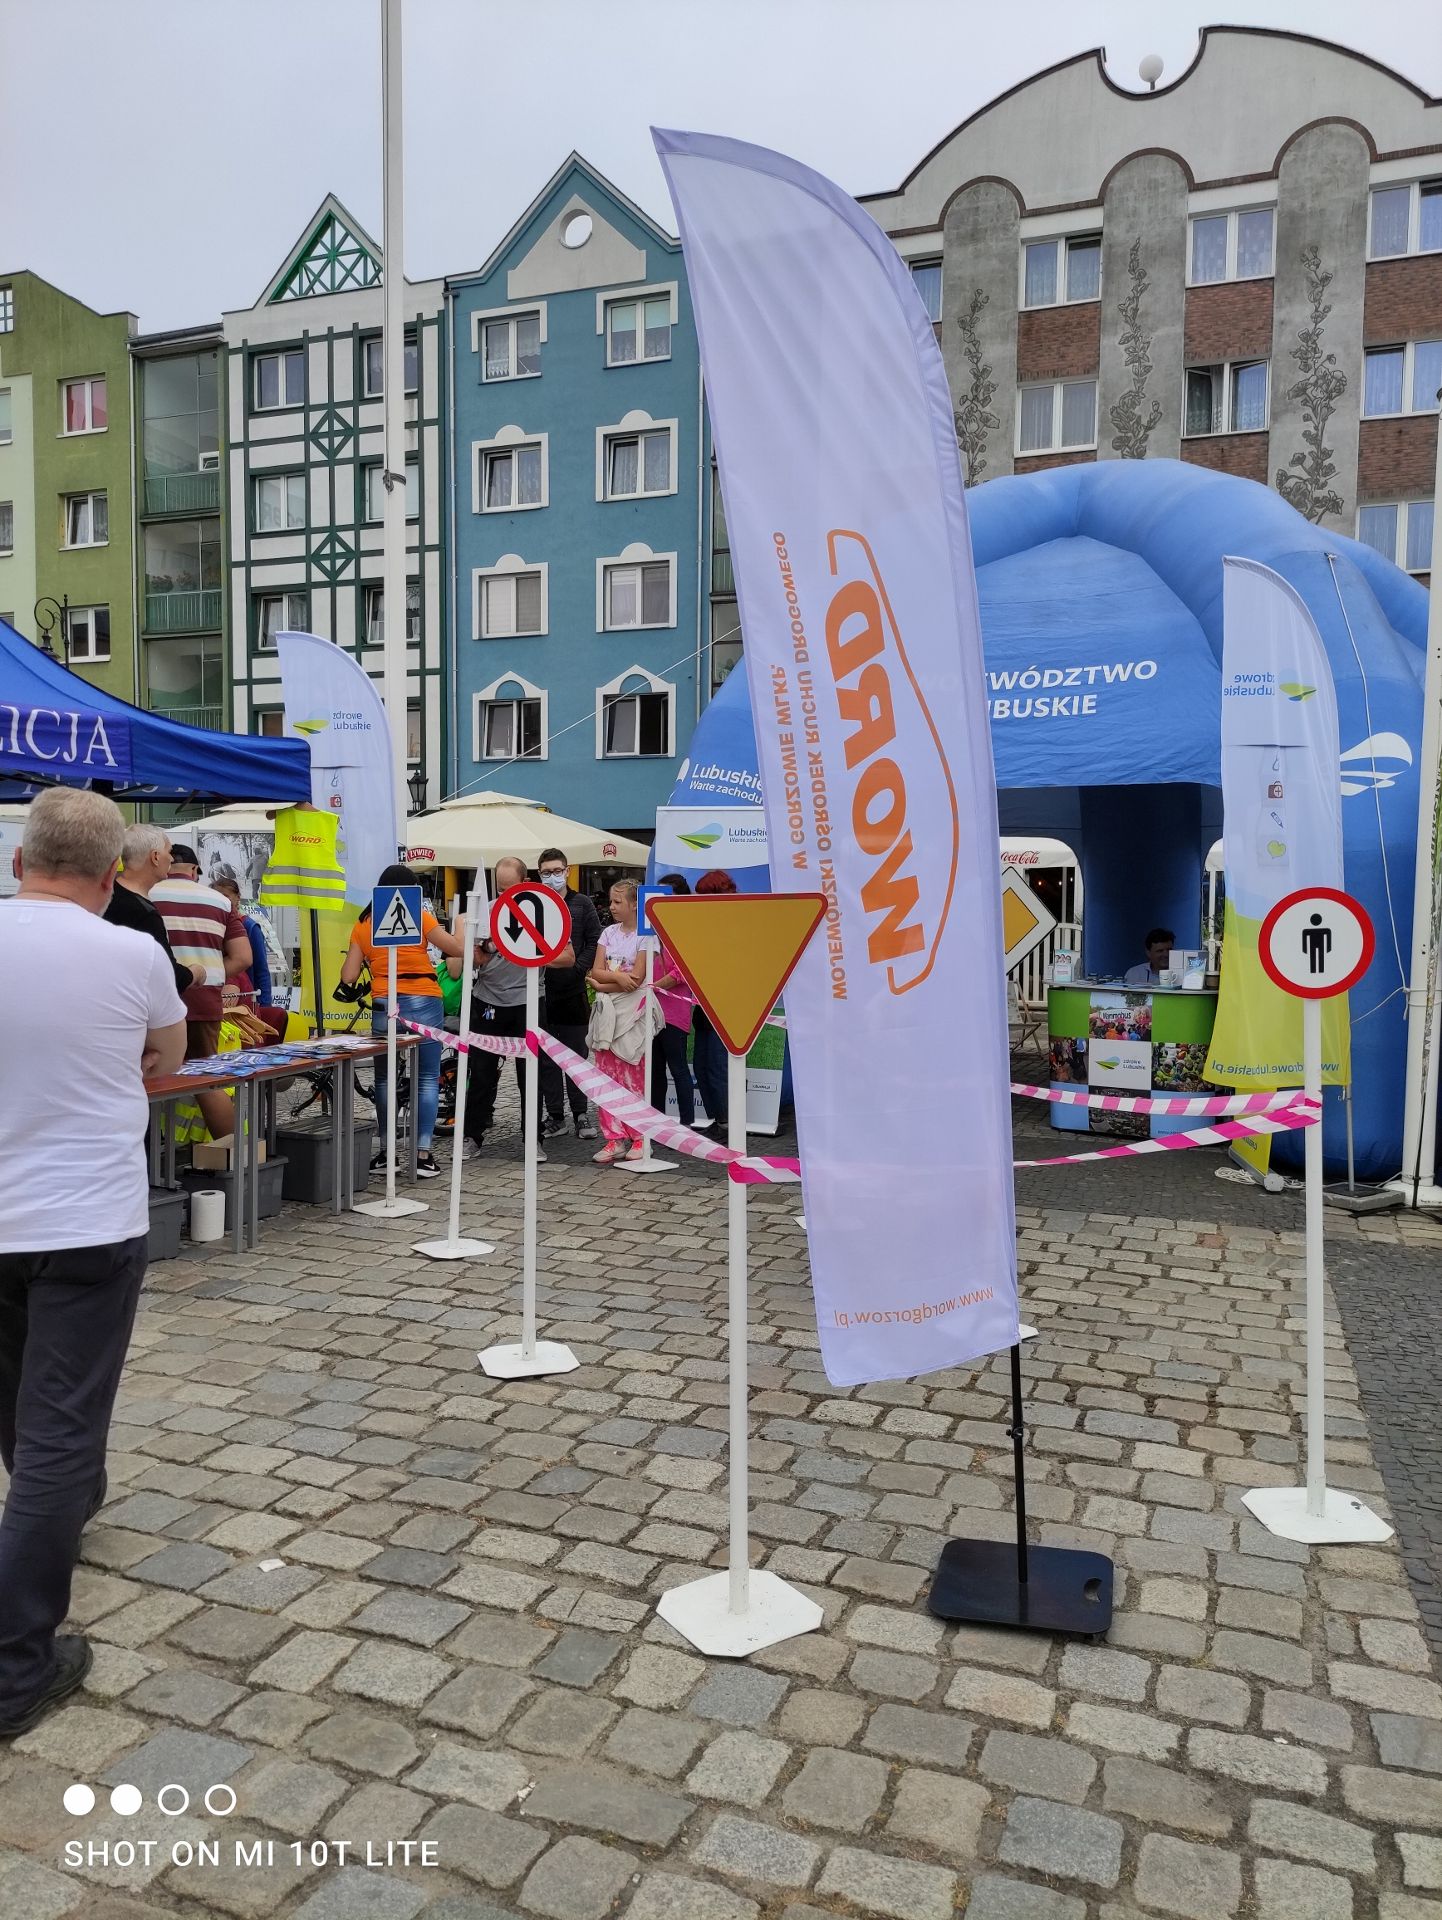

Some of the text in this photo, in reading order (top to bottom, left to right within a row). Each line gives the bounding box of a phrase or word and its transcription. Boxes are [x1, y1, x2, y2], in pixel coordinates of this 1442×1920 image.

[984, 660, 1158, 691] WÓDZTWO
[987, 694, 1098, 719] BUSKIE
[0, 705, 118, 767] ICJA
[689, 780, 715, 792] Warte
[291, 835, 321, 844] WORD
